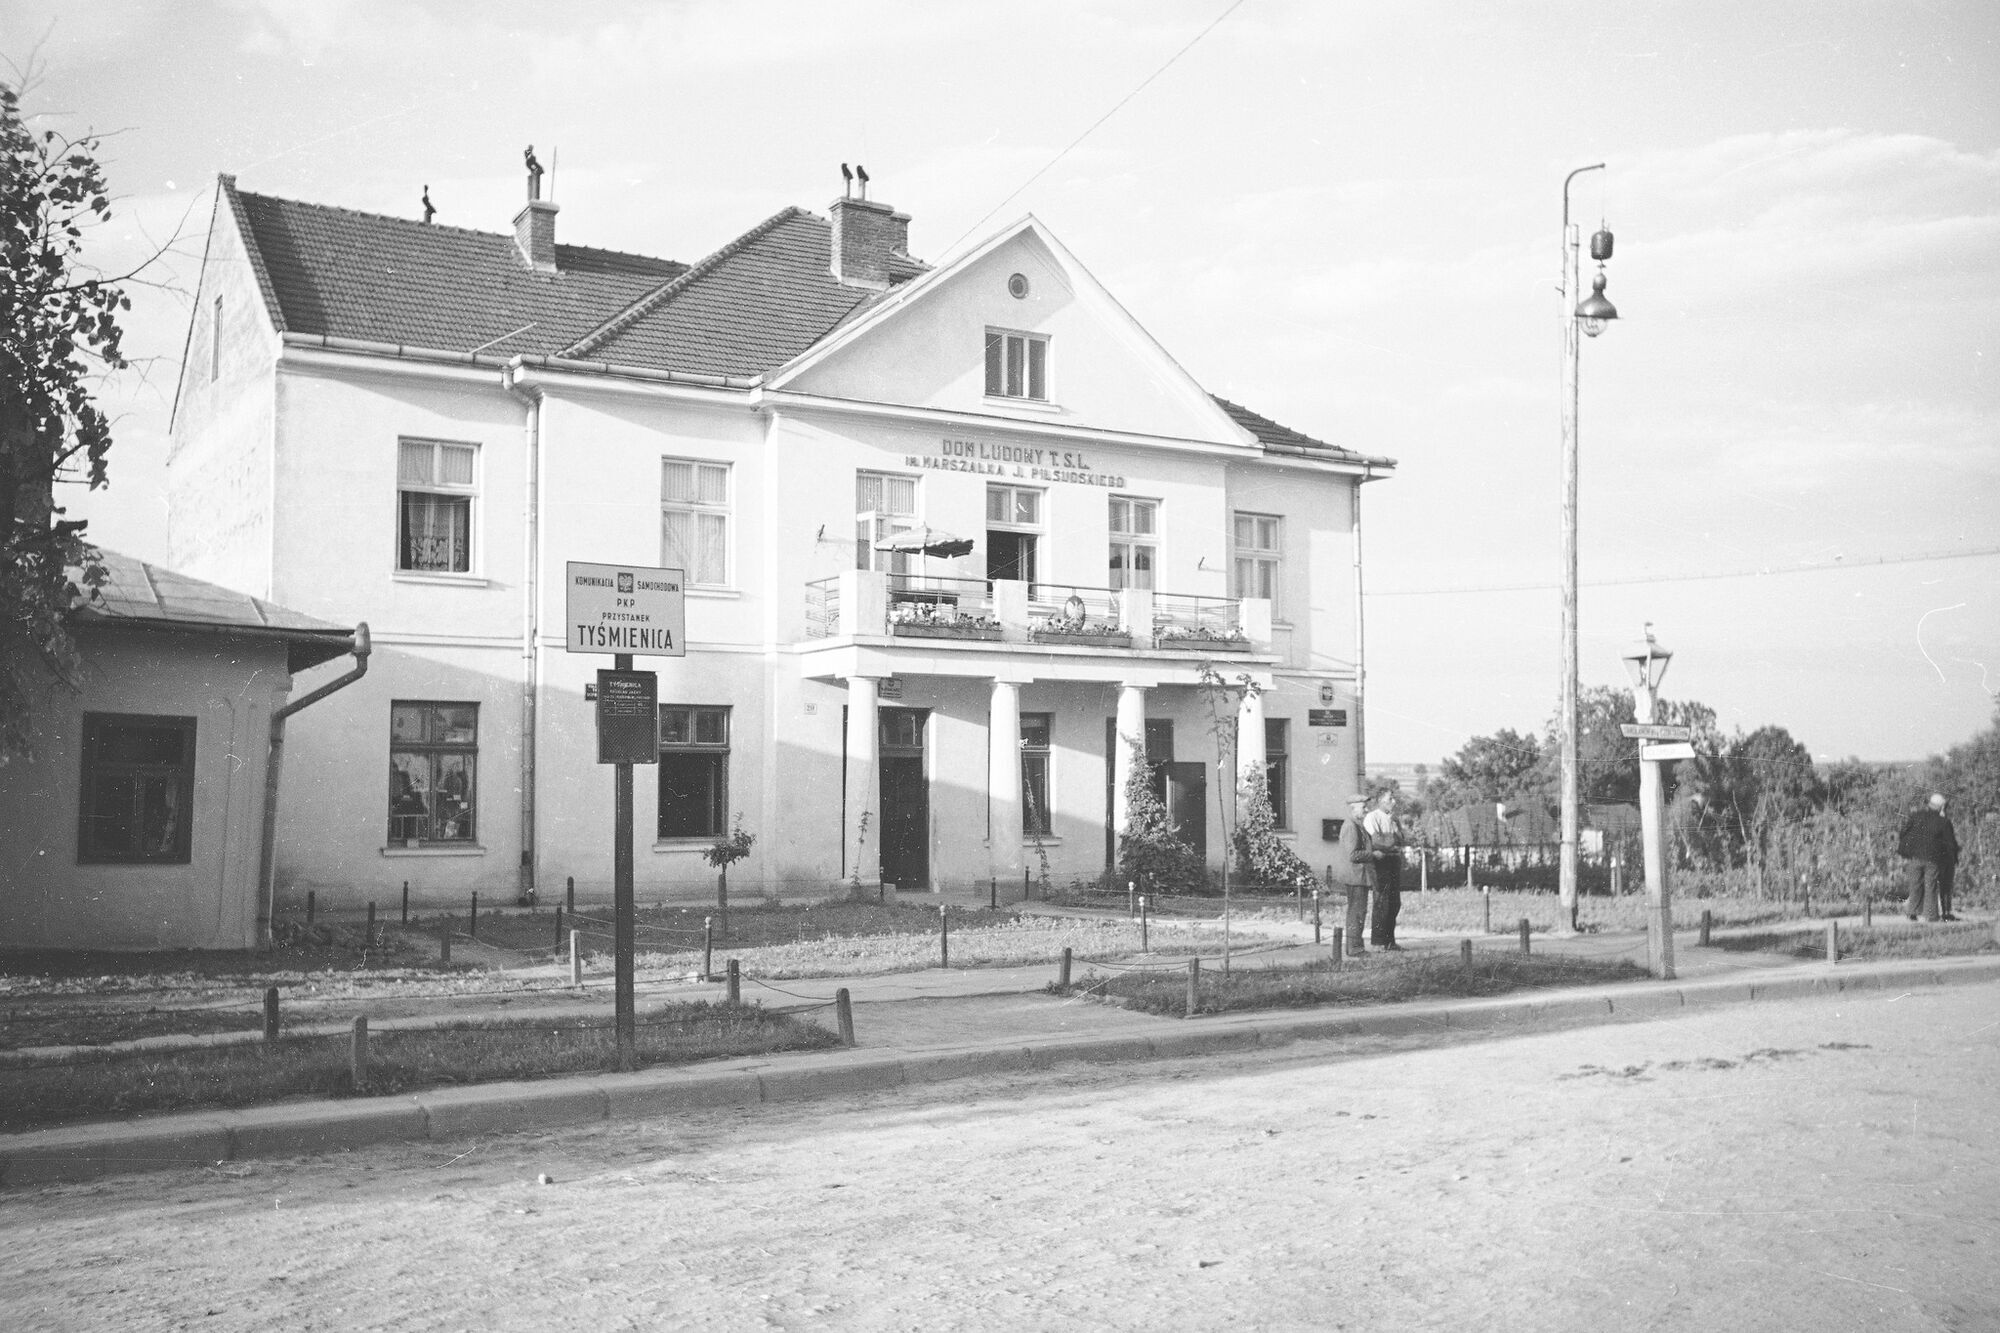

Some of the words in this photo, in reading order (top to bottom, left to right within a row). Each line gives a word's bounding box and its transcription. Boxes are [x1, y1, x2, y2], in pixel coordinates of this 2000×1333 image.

[943, 439, 974, 457] DOM
[980, 443, 1043, 465] LUDOWY
[637, 580, 679, 592] SAMOCHODOWA
[617, 598, 635, 608] PKP
[602, 612, 650, 622] PRZYSTANEK
[577, 622, 673, 650] TYŚMIENICA
